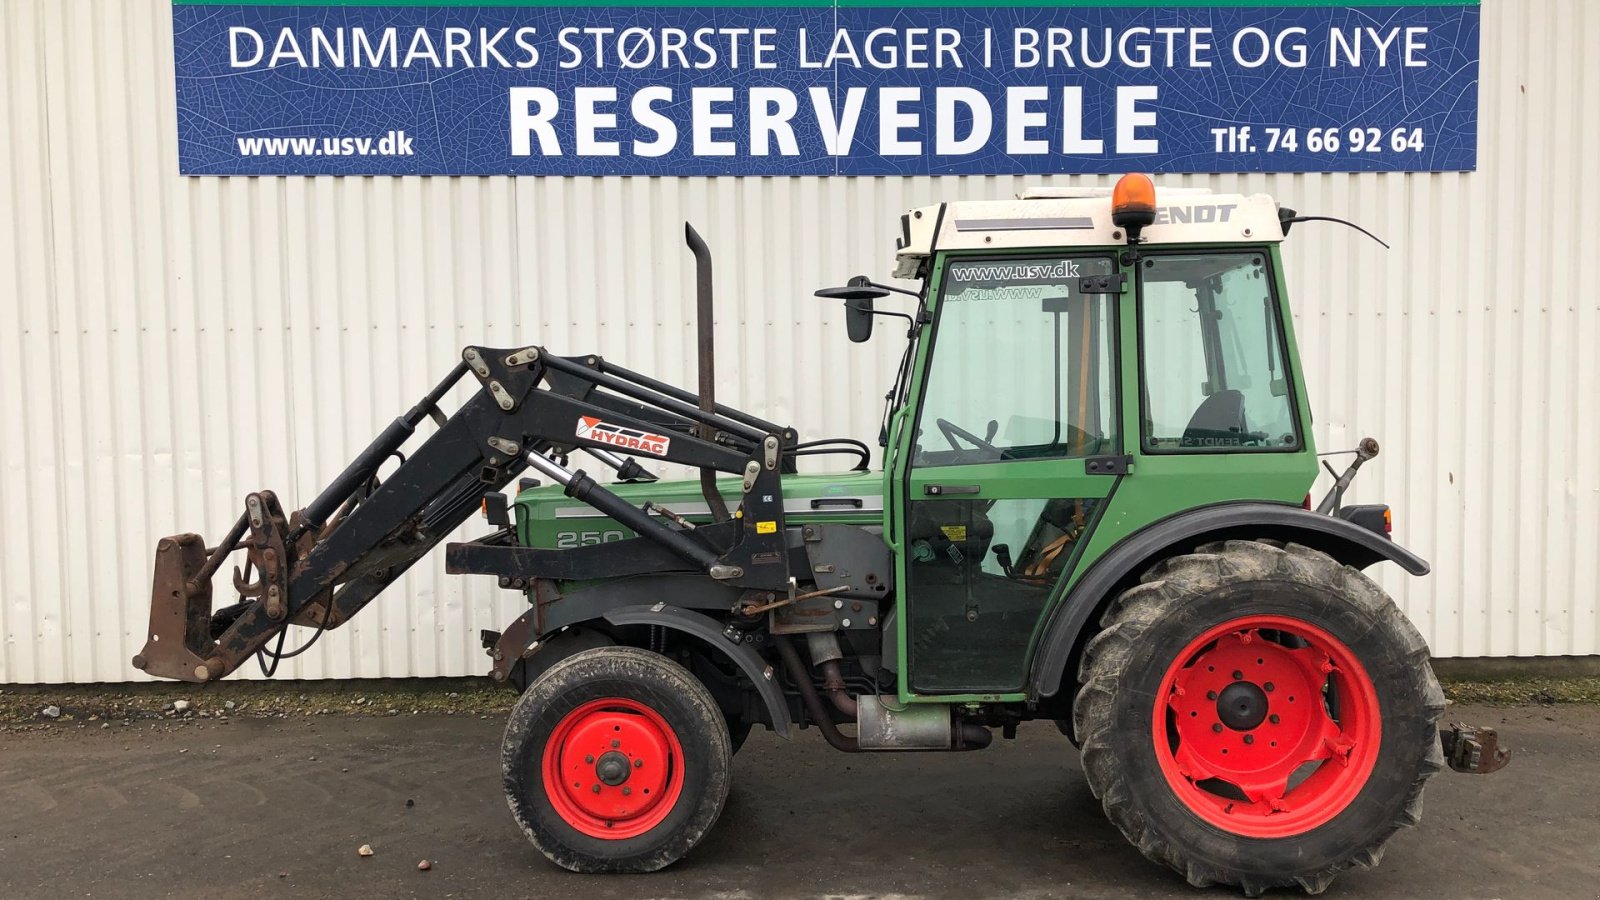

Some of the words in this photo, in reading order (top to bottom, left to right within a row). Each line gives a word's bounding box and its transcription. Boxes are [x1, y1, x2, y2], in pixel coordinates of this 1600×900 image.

[229, 26, 539, 69] DANMARKS
[558, 27, 777, 70] STØRSTE
[799, 27, 963, 69] LAGER
[984, 28, 991, 68] I
[1014, 27, 1213, 69] BRUGTE
[1232, 27, 1307, 69] OG
[1329, 27, 1428, 68] NYE
[509, 85, 1159, 157] RESERVEDELE
[237, 130, 414, 156] www.usv.dk
[1211, 126, 1256, 153] Tlf.
[1265, 127, 1298, 152] 74
[1306, 127, 1340, 153] 66
[1349, 127, 1382, 153] 92
[1391, 127, 1425, 153] 64
[1153, 204, 1237, 225] ENDT
[952, 260, 1080, 281] www.usv.dk
[590, 429, 665, 454] HYDRAC
[557, 530, 624, 549] 250
